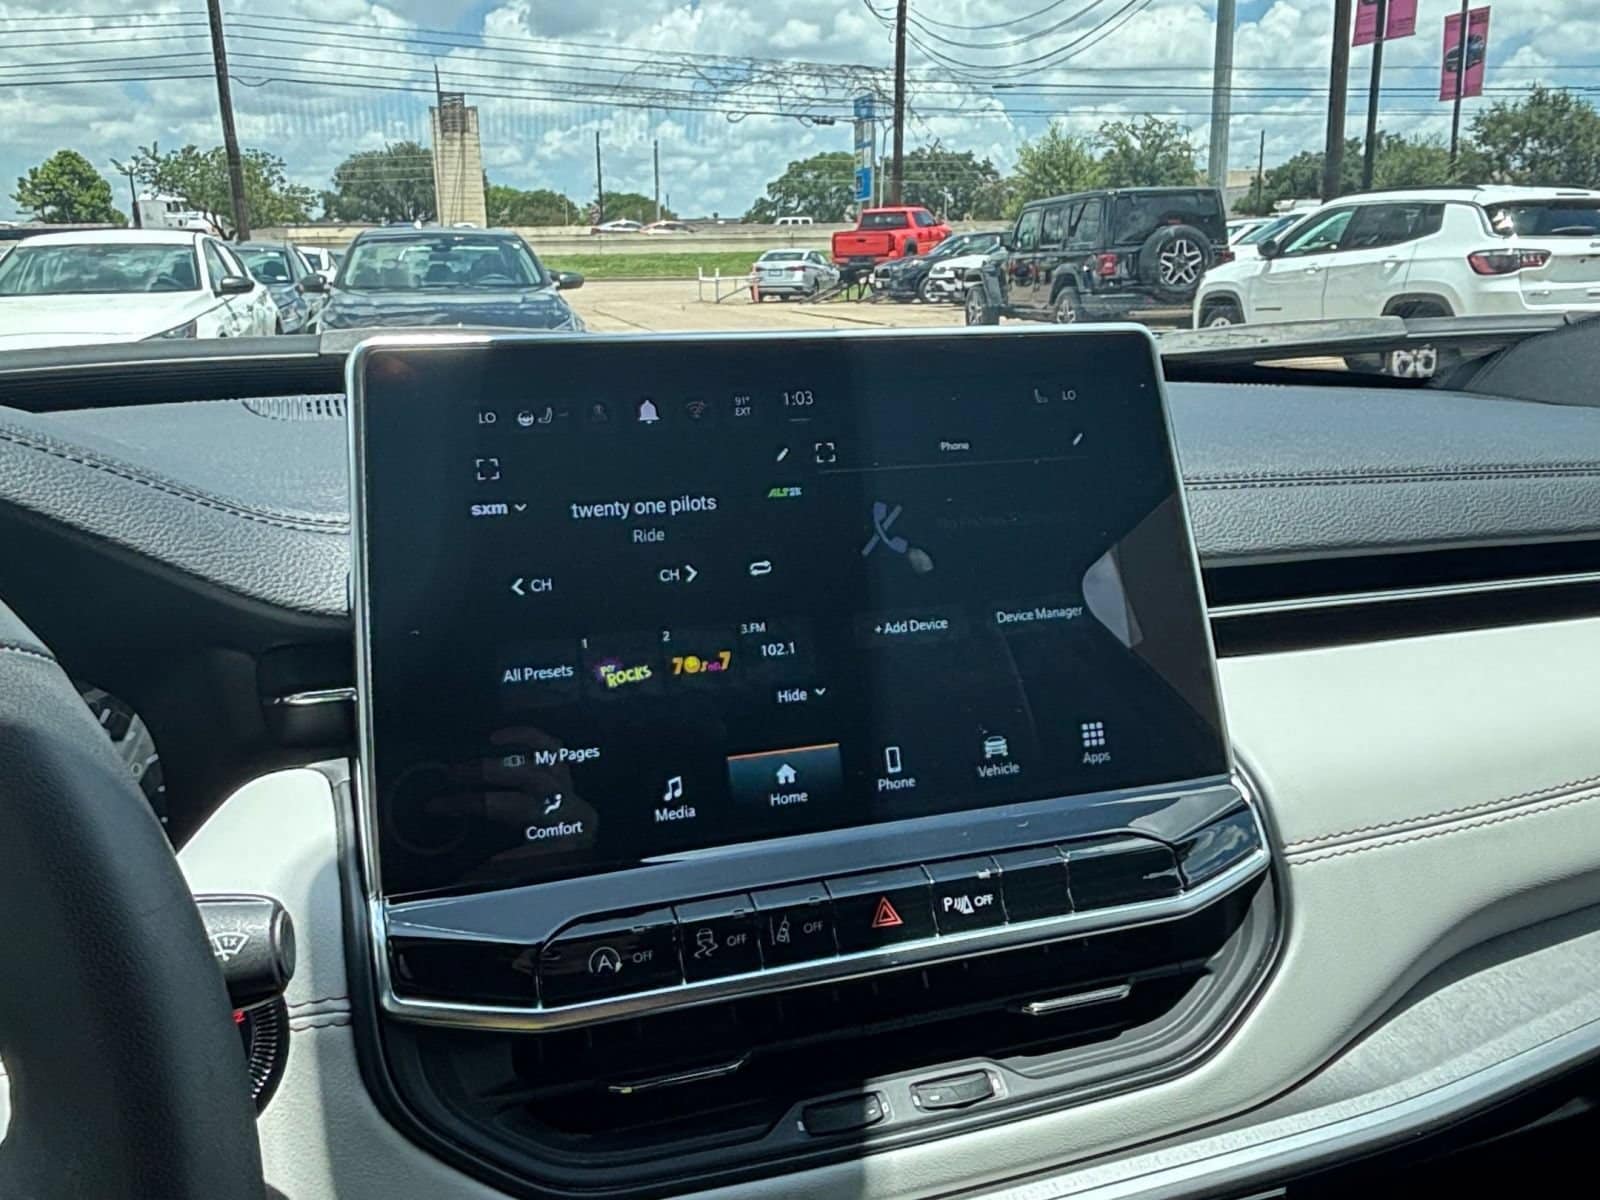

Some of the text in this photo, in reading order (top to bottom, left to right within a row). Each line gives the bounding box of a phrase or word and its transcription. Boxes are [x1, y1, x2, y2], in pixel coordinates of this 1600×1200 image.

[783, 390, 814, 406] 1:03
[478, 411, 497, 425] LO
[940, 441, 970, 451] Phone
[471, 503, 509, 516] sxm
[570, 494, 717, 520] twenty one pilots
[632, 527, 665, 543] Ride
[659, 568, 681, 582] CH
[530, 577, 553, 593] CH
[996, 606, 1083, 624] Device Manager
[883, 620, 908, 635] Add
[909, 619, 949, 633] Device
[662, 630, 671, 642] 2
[761, 641, 795, 657] 102.1
[503, 665, 574, 683] All Presets
[604, 664, 652, 688] ROCKS
[777, 688, 808, 703] Hide
[535, 747, 601, 766] My Pages
[1082, 751, 1111, 765] Apps
[977, 761, 1020, 778] Vehicle
[877, 777, 916, 792] Phone
[770, 792, 809, 807] Home
[654, 805, 697, 822] Media
[525, 821, 584, 840] Comfort
[973, 893, 994, 907] OFF
[802, 920, 823, 934] OFF
[726, 933, 747, 947] OFF
[631, 949, 653, 964] OFF
